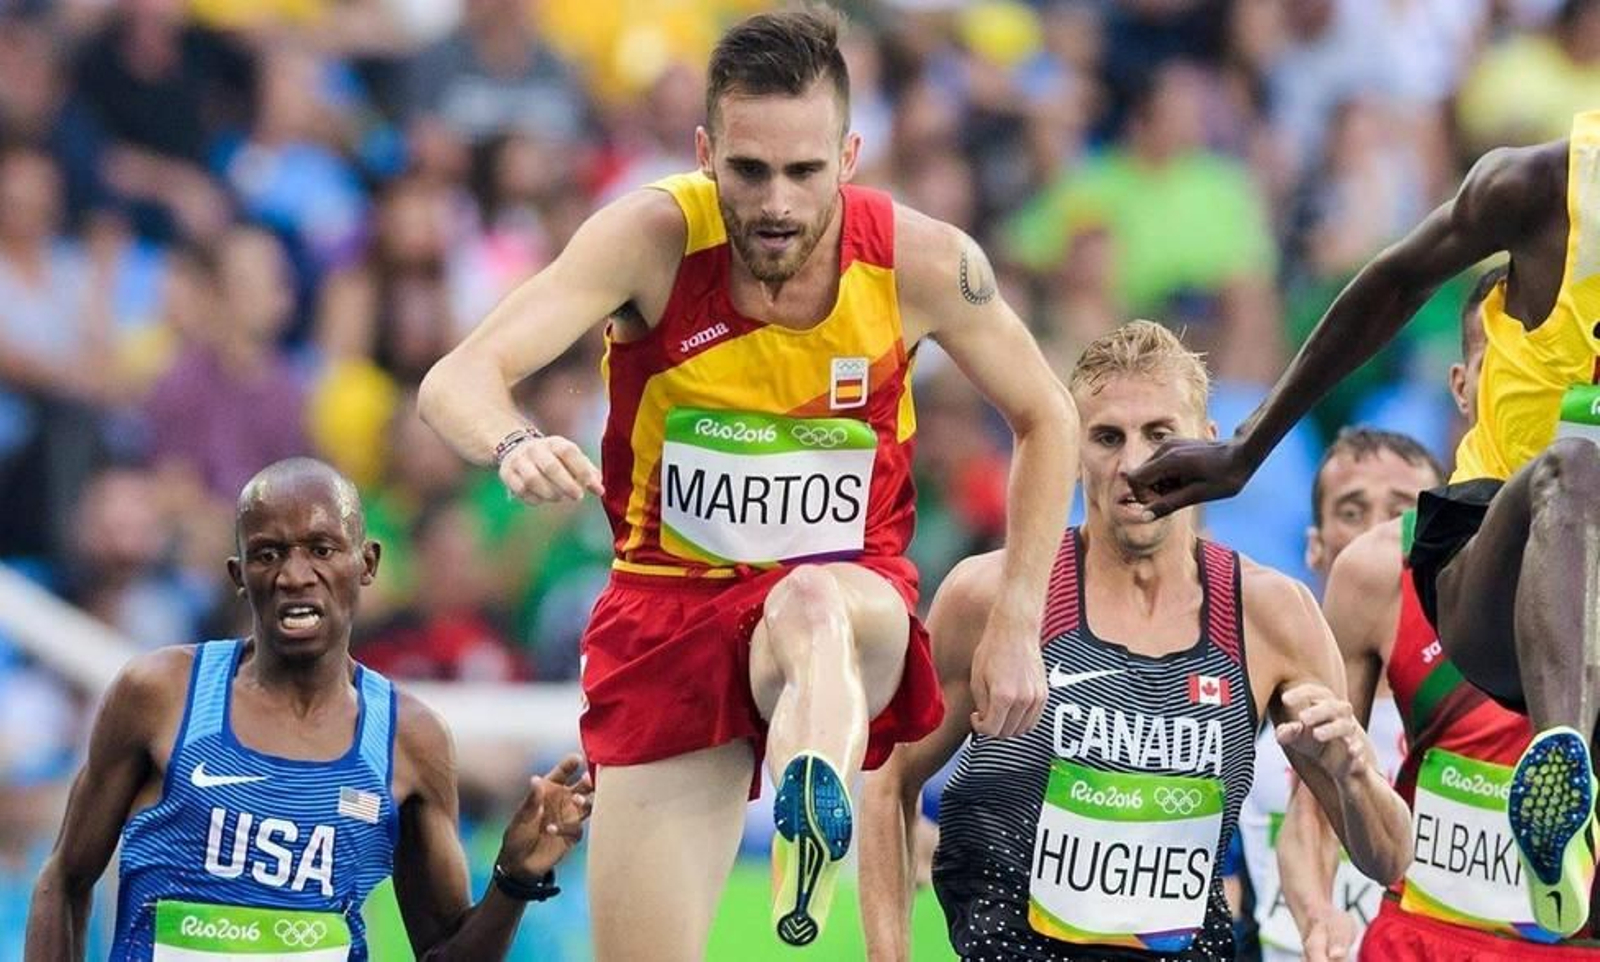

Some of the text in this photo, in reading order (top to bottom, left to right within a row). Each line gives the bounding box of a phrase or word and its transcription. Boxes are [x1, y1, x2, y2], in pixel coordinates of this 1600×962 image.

[695, 418, 777, 443] Rio2016
[666, 464, 862, 524] MARTOS
[1053, 703, 1223, 775] CANADA
[1070, 780, 1144, 809] Rio2016
[204, 807, 335, 897] USA
[1036, 828, 1209, 901] HUGHES
[180, 915, 262, 941] Rio2016
